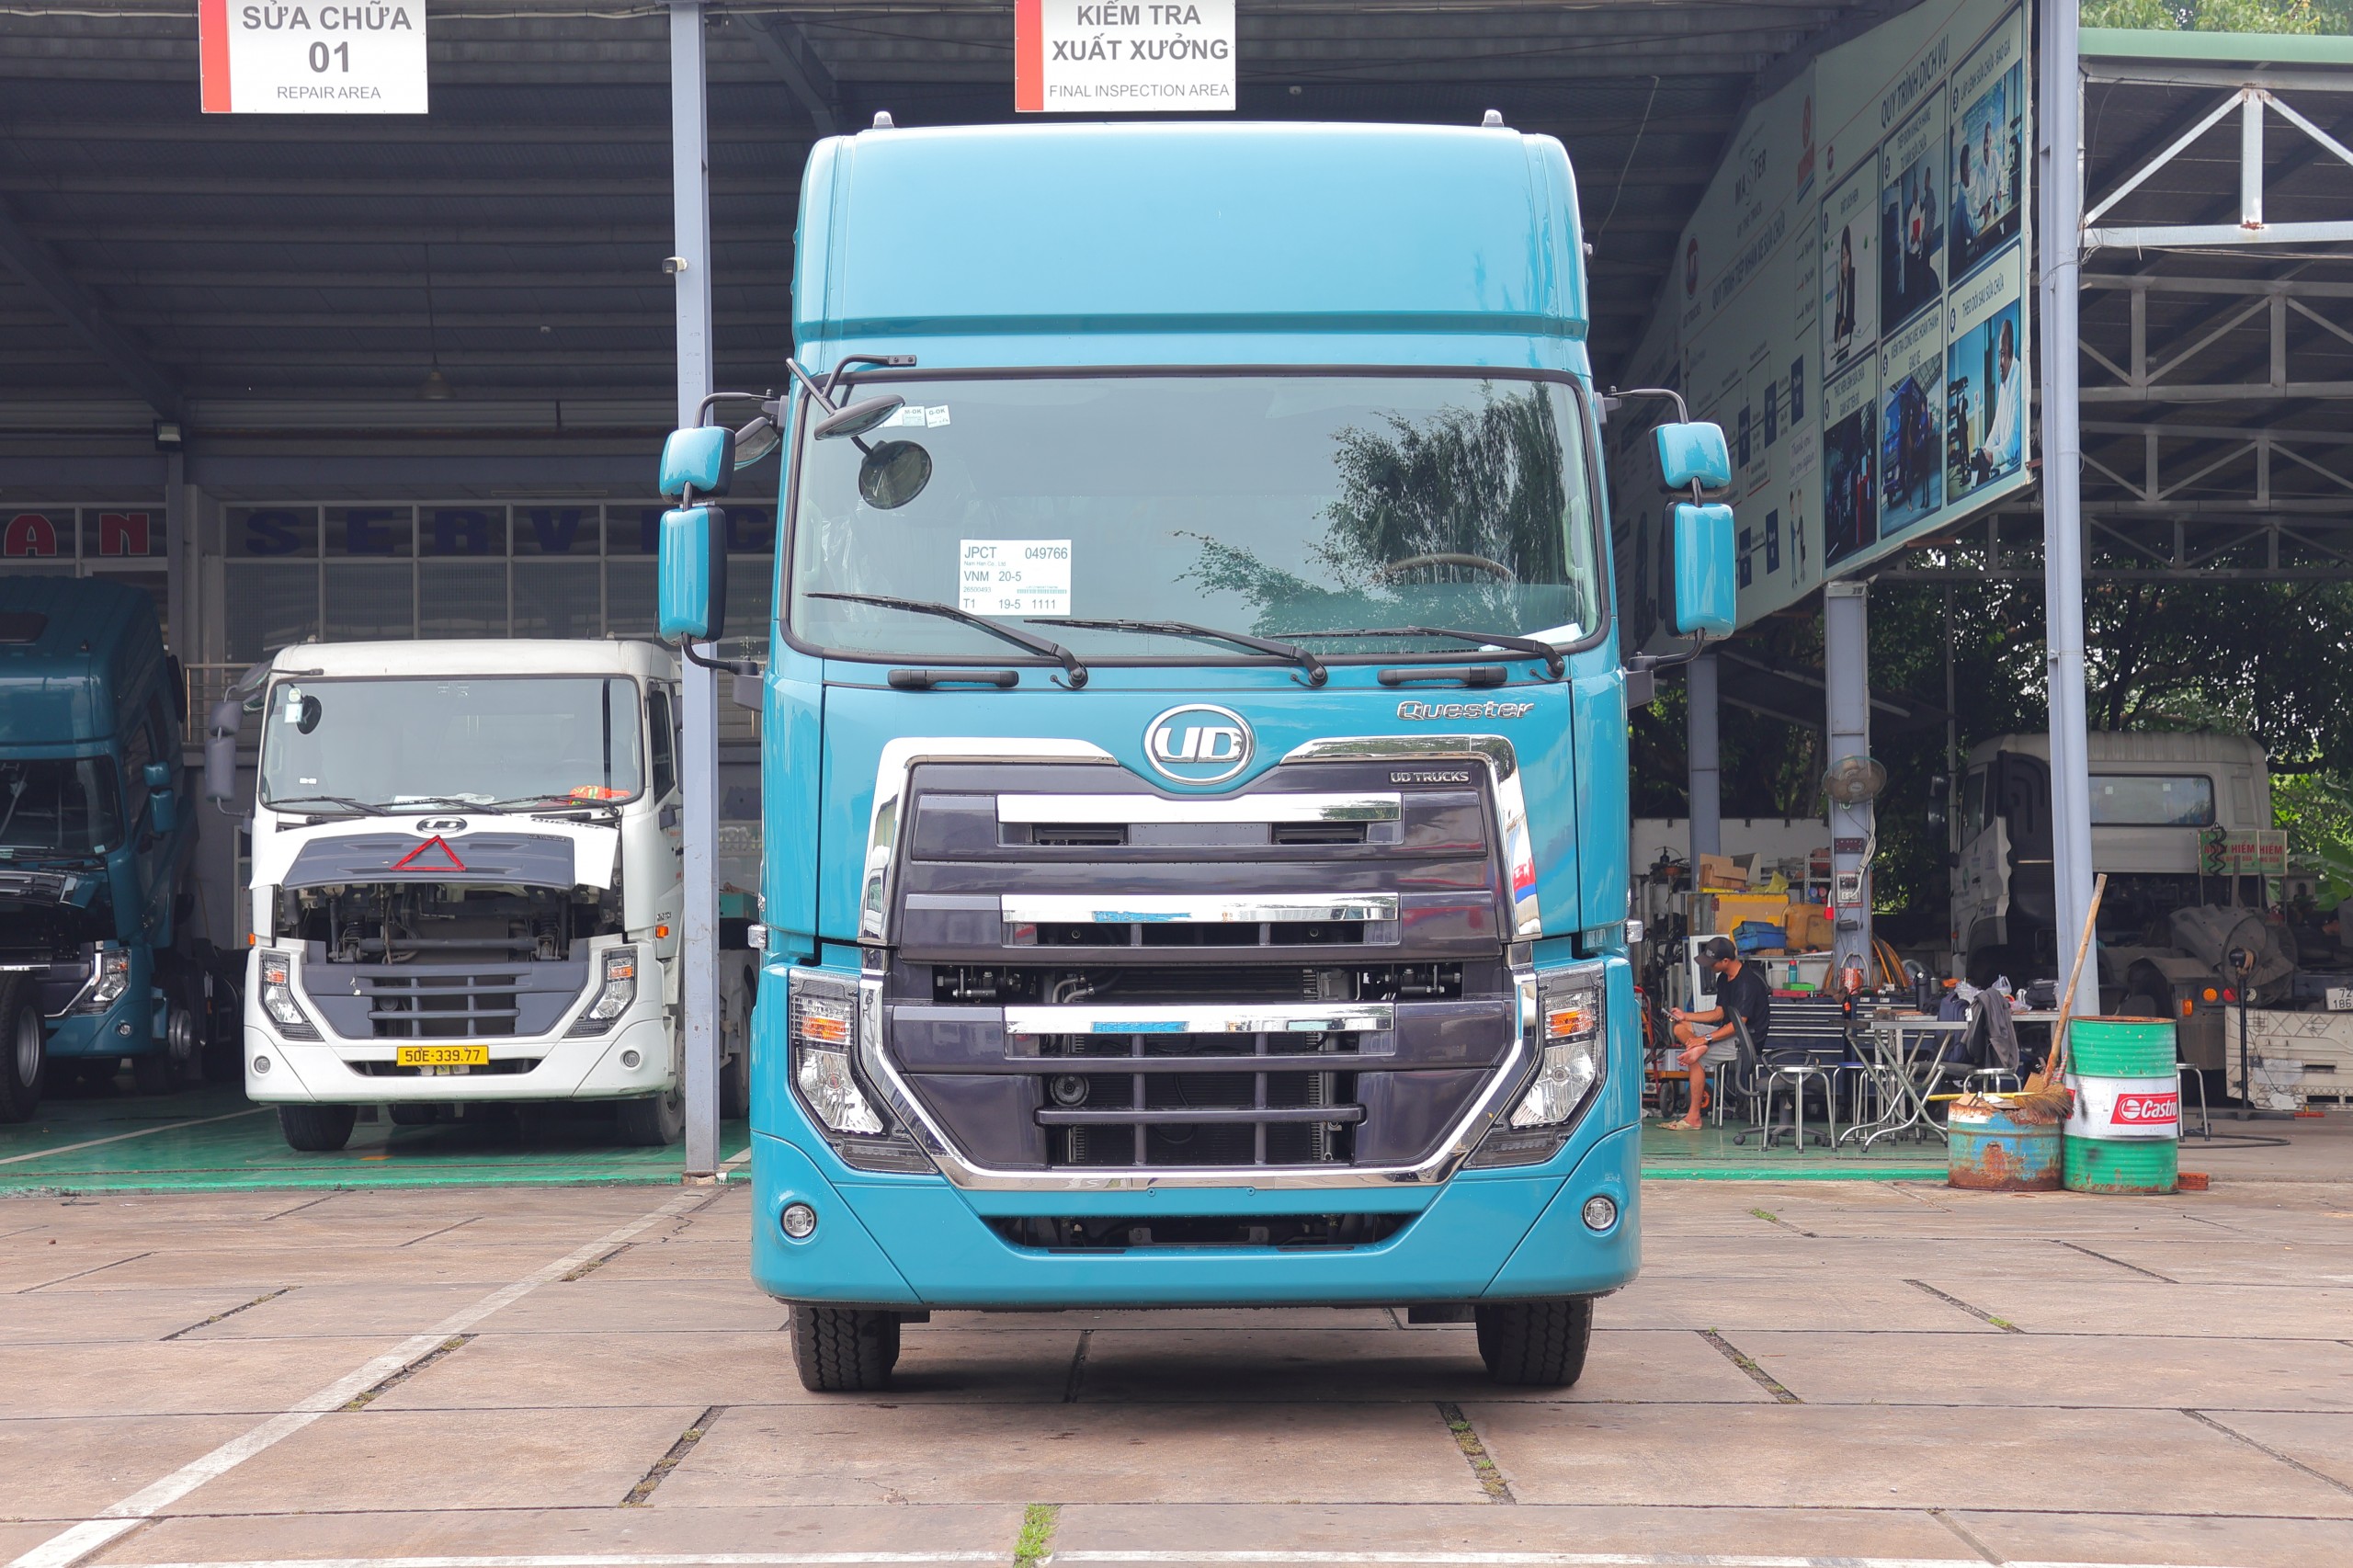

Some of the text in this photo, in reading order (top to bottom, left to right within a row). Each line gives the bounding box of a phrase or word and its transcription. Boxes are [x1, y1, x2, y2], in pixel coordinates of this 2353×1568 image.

[243, 0, 412, 30] SỬA CHỮA
[1148, 5, 1201, 25] TRA
[1051, 32, 1229, 61] XUẤT XƯỞNG
[309, 41, 349, 73] 01
[278, 86, 381, 99] REPAIR AREA
[1050, 84, 1230, 97] FINAL INSPECTION AREA
[965, 546, 1068, 559] JPCT 049766
[964, 571, 1021, 582] VNM 20-5
[963, 598, 1055, 609] T1 19-5 1111
[1397, 700, 1535, 721] Quester
[1154, 726, 1243, 763] UD
[1390, 771, 1470, 782] UD TRUCKS
[405, 1050, 480, 1062] 50E-339.77
